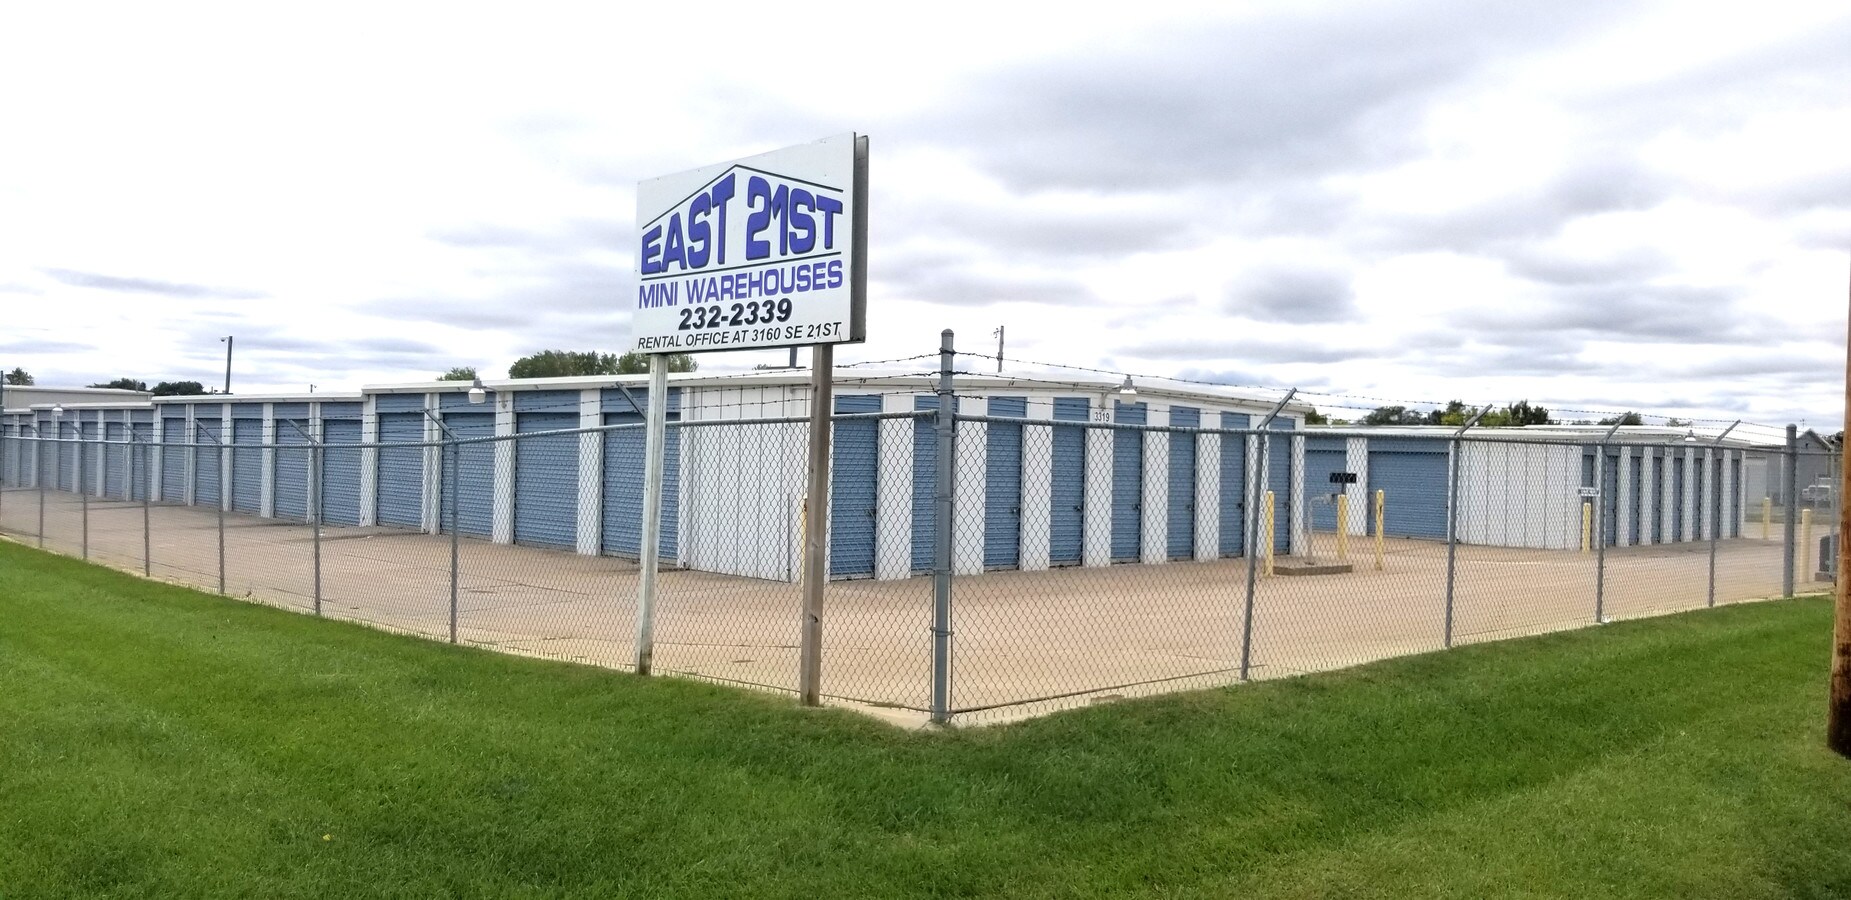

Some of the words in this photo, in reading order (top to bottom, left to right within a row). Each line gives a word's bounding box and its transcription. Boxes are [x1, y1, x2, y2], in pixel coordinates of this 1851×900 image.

[641, 172, 735, 276] EAST
[746, 175, 843, 261] 21ST
[638, 281, 679, 310] MINI
[686, 259, 844, 304] WAREHOUSES
[678, 298, 793, 331] 232-2339
[637, 334, 682, 349] RENTAL
[685, 331, 729, 347] OFFICE
[732, 329, 749, 343] AT
[751, 326, 781, 342] 3160
[784, 325, 804, 339] SE
[807, 321, 842, 338] 21ST
[1094, 411, 1110, 422] 3319
